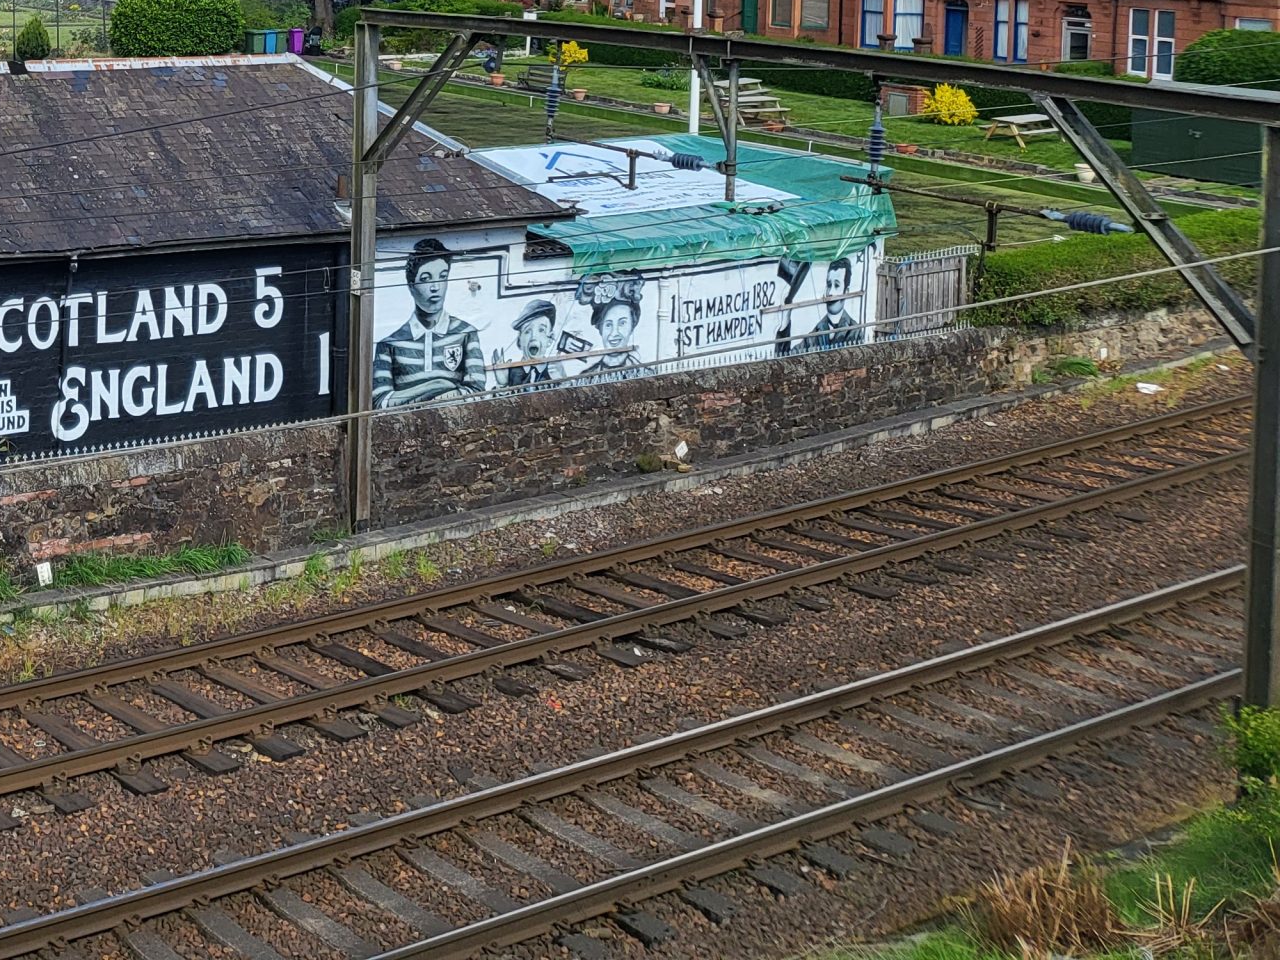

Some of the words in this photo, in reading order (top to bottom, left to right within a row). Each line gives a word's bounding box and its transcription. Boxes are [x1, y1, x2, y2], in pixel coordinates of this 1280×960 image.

[254, 266, 284, 328] 5
[705, 291, 750, 319] MARCH
[752, 280, 776, 310] 1882
[706, 309, 763, 345] HAMPDEN
[51, 353, 284, 442] ENGLAND
[318, 331, 330, 395] 1
